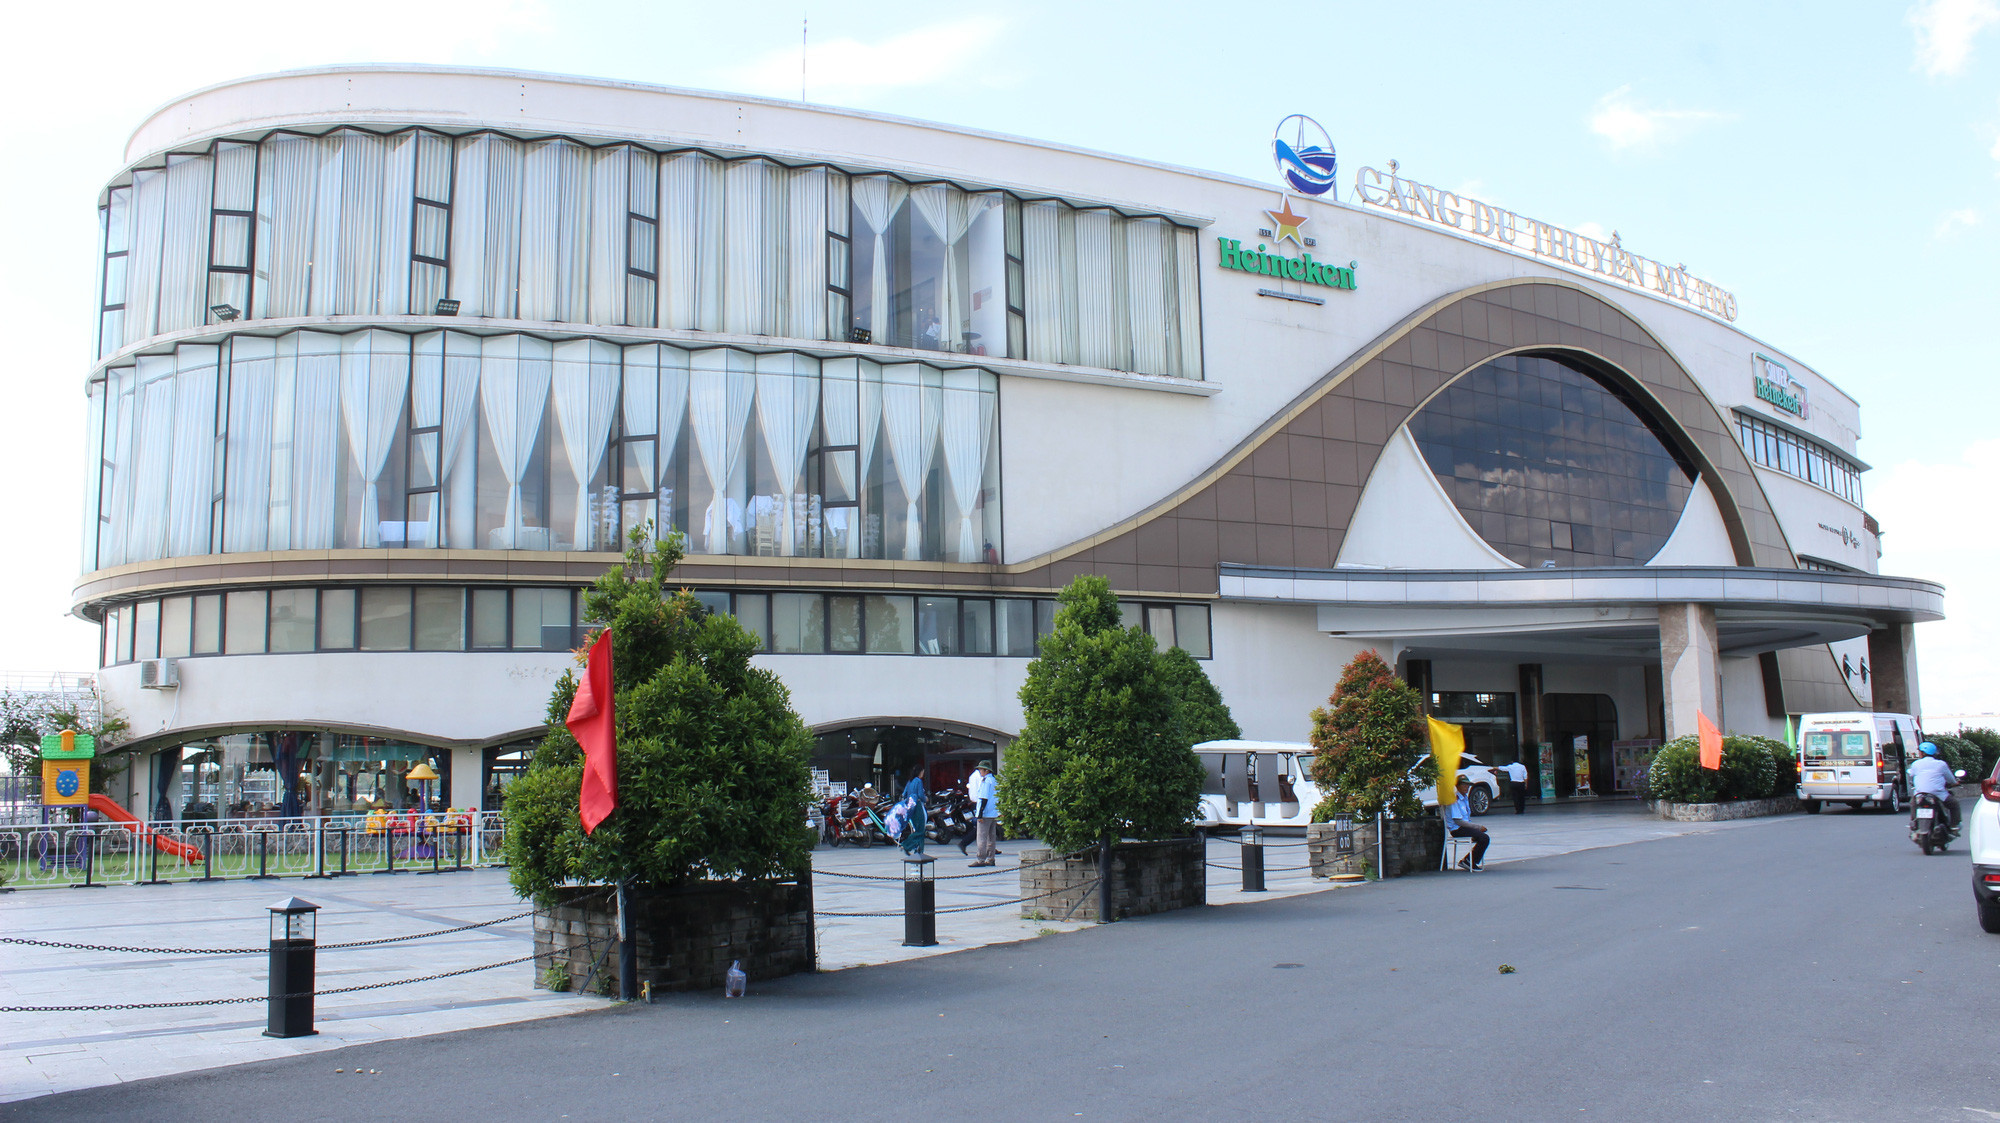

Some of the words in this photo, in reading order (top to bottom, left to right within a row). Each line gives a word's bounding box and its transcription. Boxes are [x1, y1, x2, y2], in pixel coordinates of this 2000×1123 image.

[1355, 159, 1463, 228] CẢNG
[1471, 199, 1517, 245] DU
[1652, 262, 1691, 303] MỸ
[1218, 236, 1358, 290] Heineken
[1755, 376, 1799, 414] Heineken
